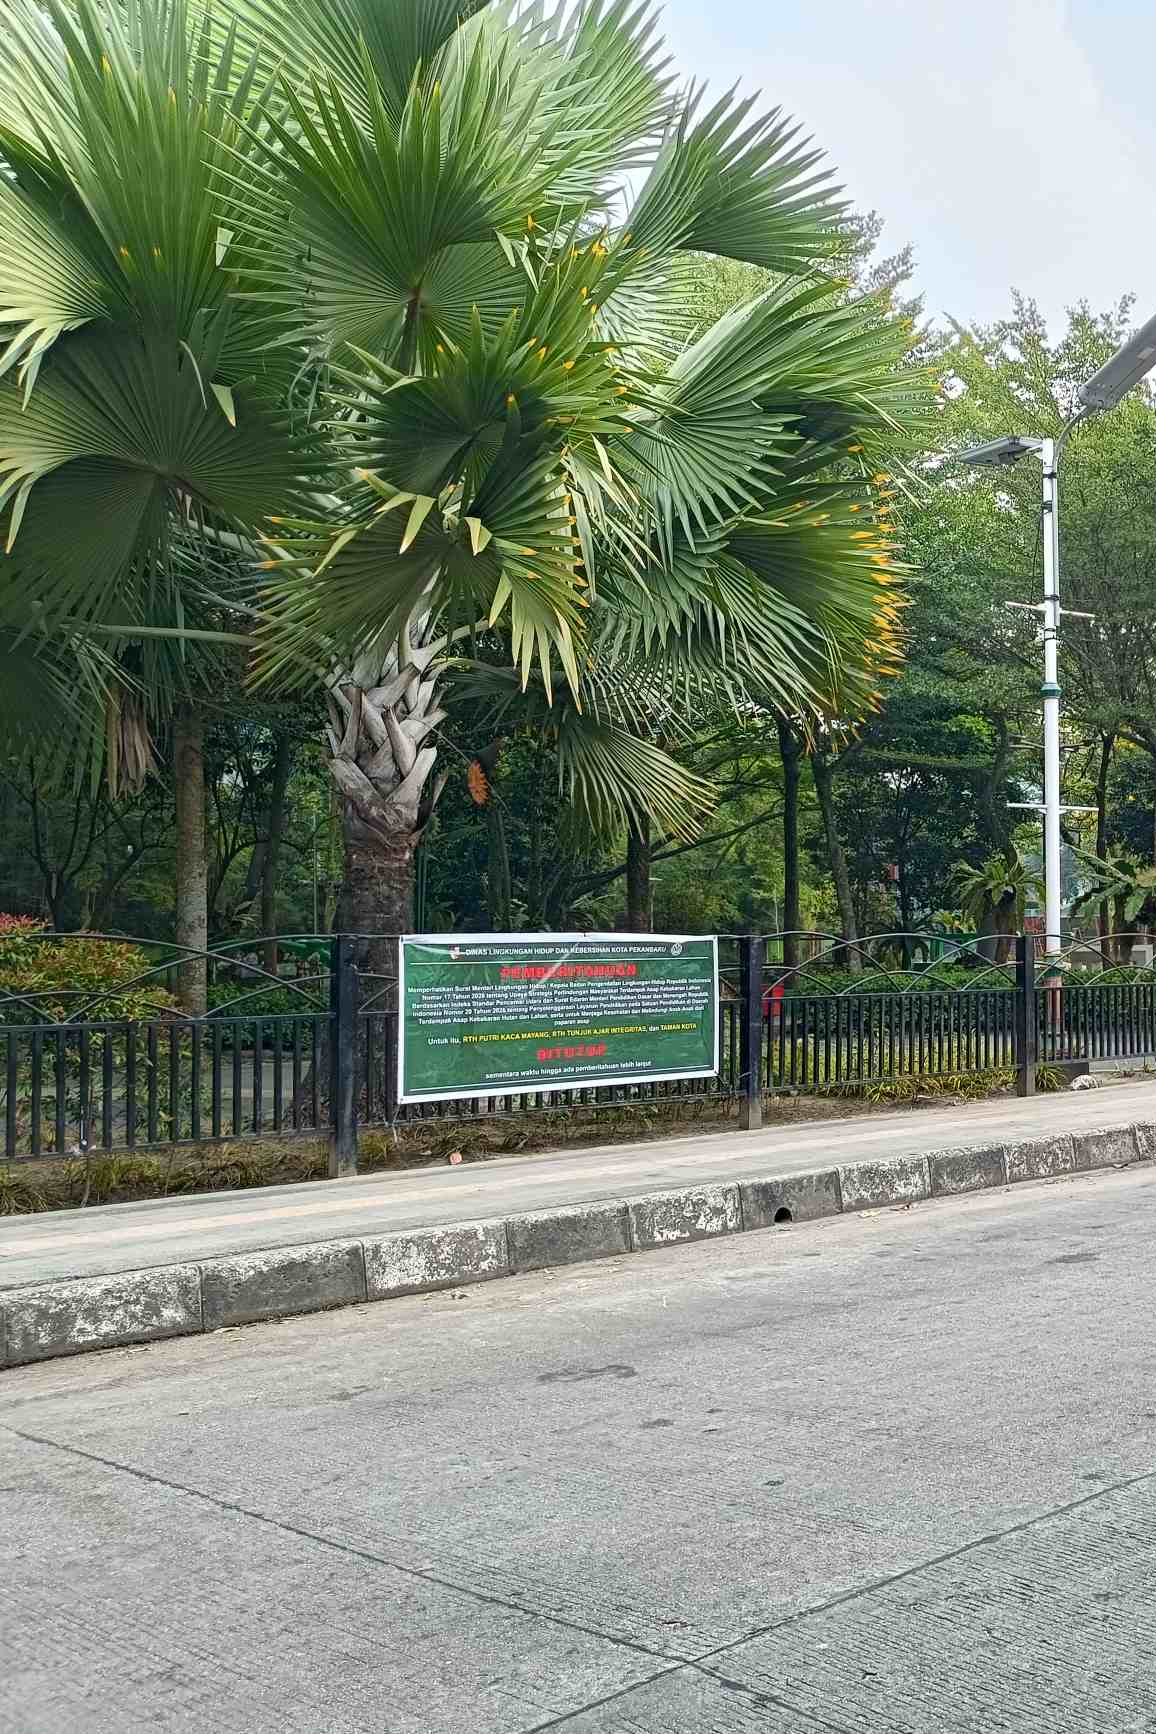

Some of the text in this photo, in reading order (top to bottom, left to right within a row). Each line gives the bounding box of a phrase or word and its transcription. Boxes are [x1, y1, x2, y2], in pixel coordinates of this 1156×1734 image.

[499, 964, 638, 979] PEMBERITAHUAN
[427, 1037, 448, 1045] Untuk
[567, 1029, 592, 1037] TUNJUK
[485, 1070, 520, 1079] sementara
[541, 1067, 562, 1076] hingga
[575, 1062, 619, 1073] pemberitahuan
